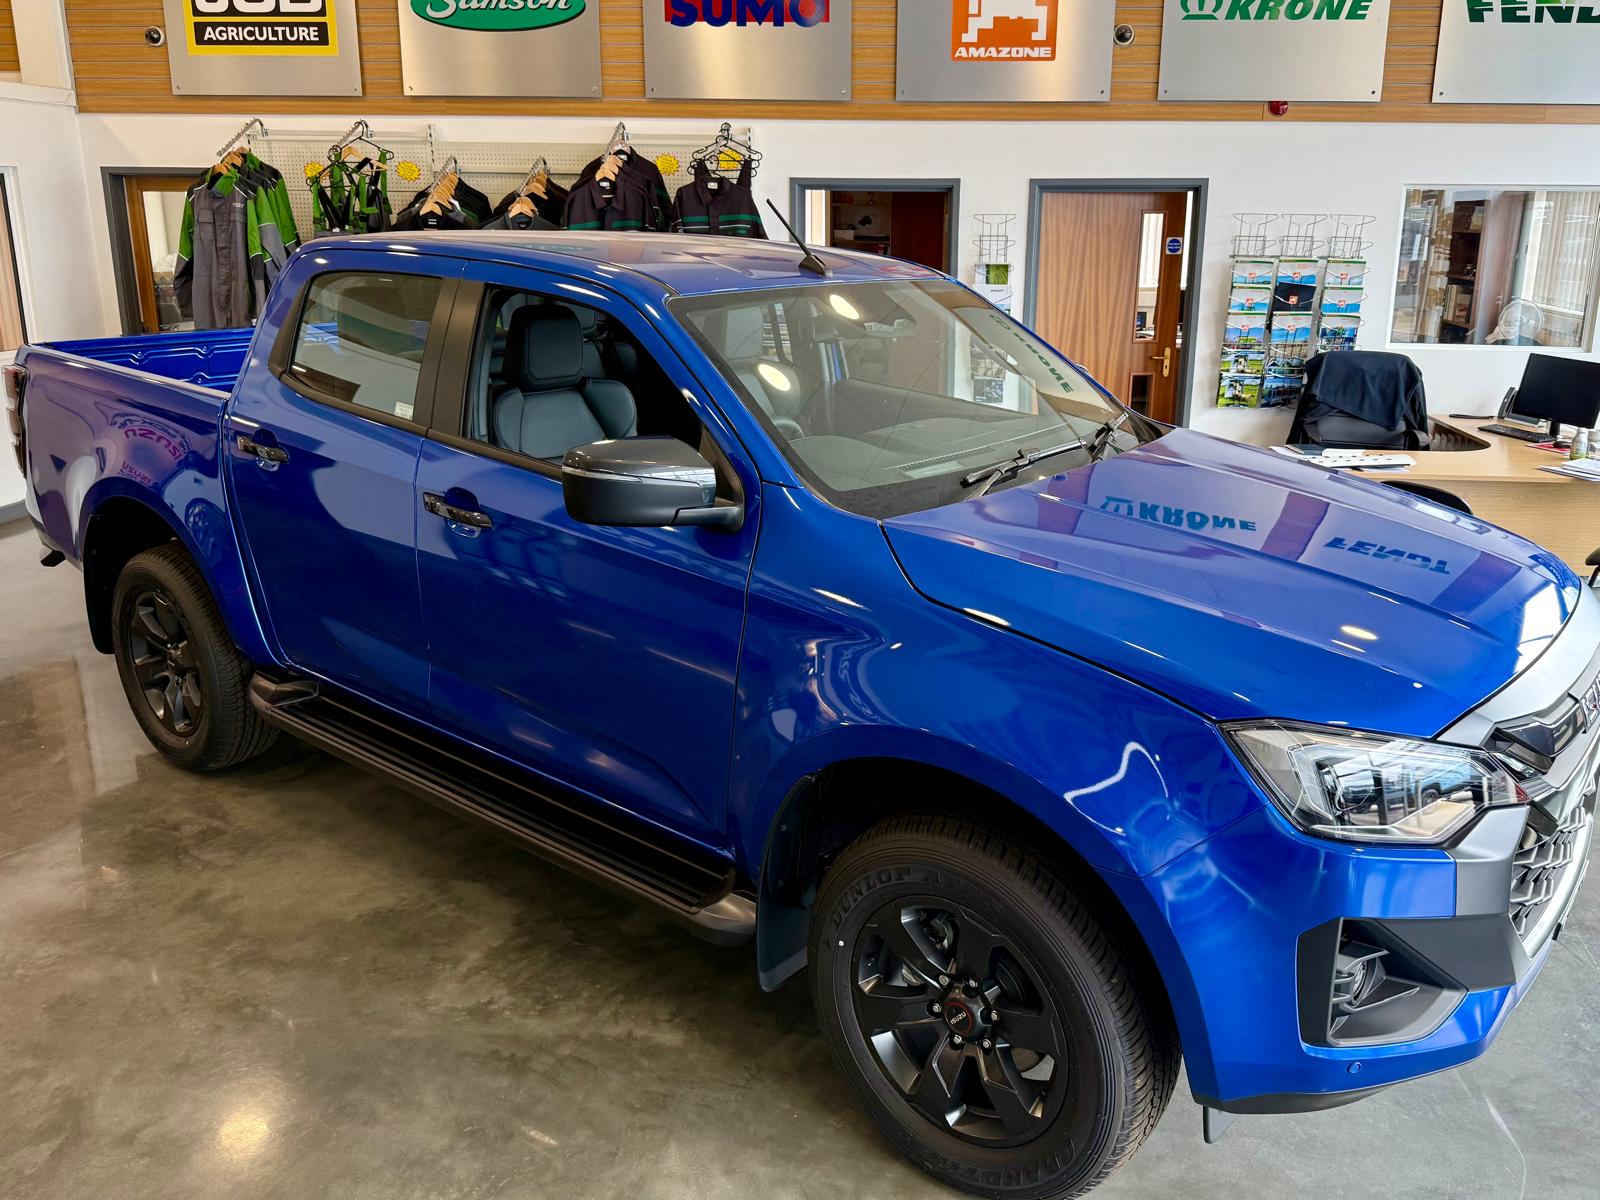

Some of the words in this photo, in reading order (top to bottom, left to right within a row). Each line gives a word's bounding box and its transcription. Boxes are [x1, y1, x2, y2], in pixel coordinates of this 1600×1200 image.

[671, 0, 825, 27] SUMO
[1224, 0, 1373, 20] KRONE
[204, 26, 319, 41] AGRICULTURE
[954, 47, 1052, 58] AMAZONE
[950, 1011, 967, 1025] ISUZU
